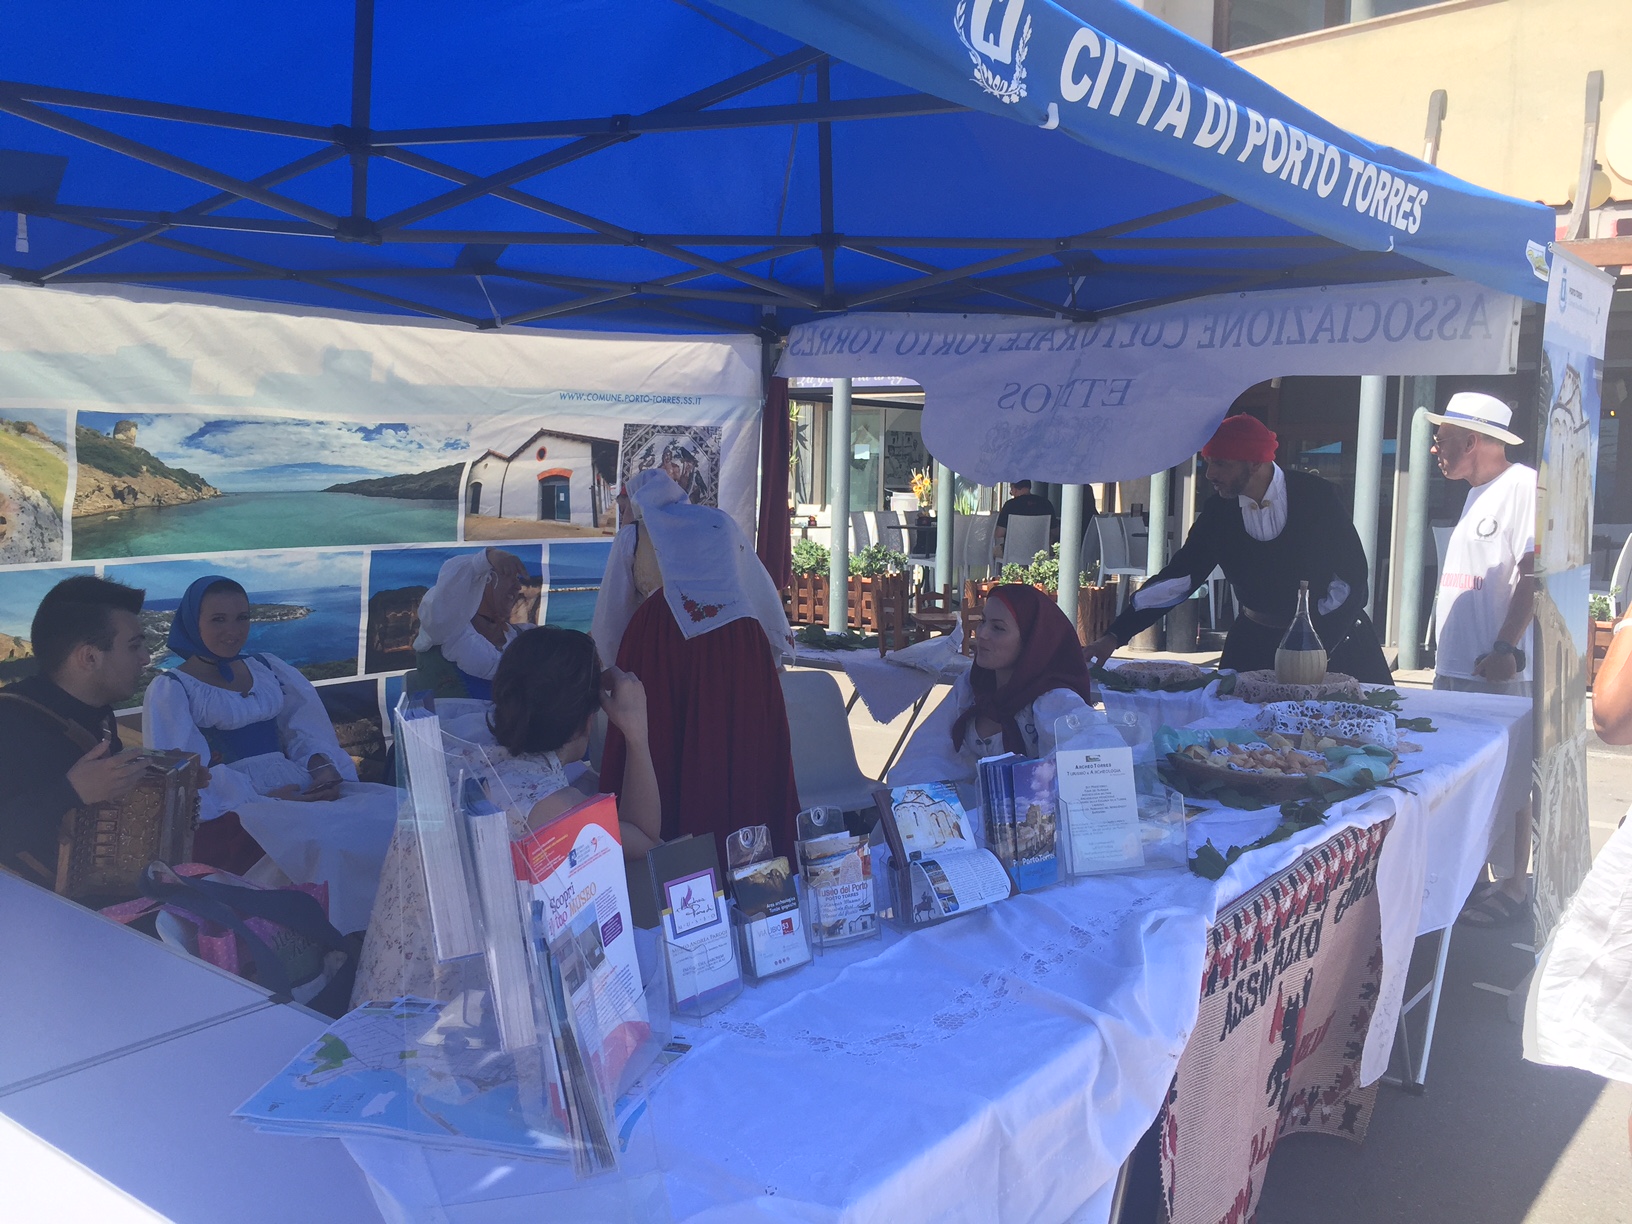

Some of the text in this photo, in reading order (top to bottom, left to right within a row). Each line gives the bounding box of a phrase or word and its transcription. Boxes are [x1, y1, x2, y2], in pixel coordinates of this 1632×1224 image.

[1060, 27, 1429, 234] CITTÀ DI PORTO TORRES
[559, 392, 702, 406] WWW.COMUNE.PORTO-TORRES.SS.IT
[549, 882, 575, 914] Scopri
[568, 881, 597, 918] MUSEO
[840, 883, 851, 895] del
[851, 881, 869, 893] Porto
